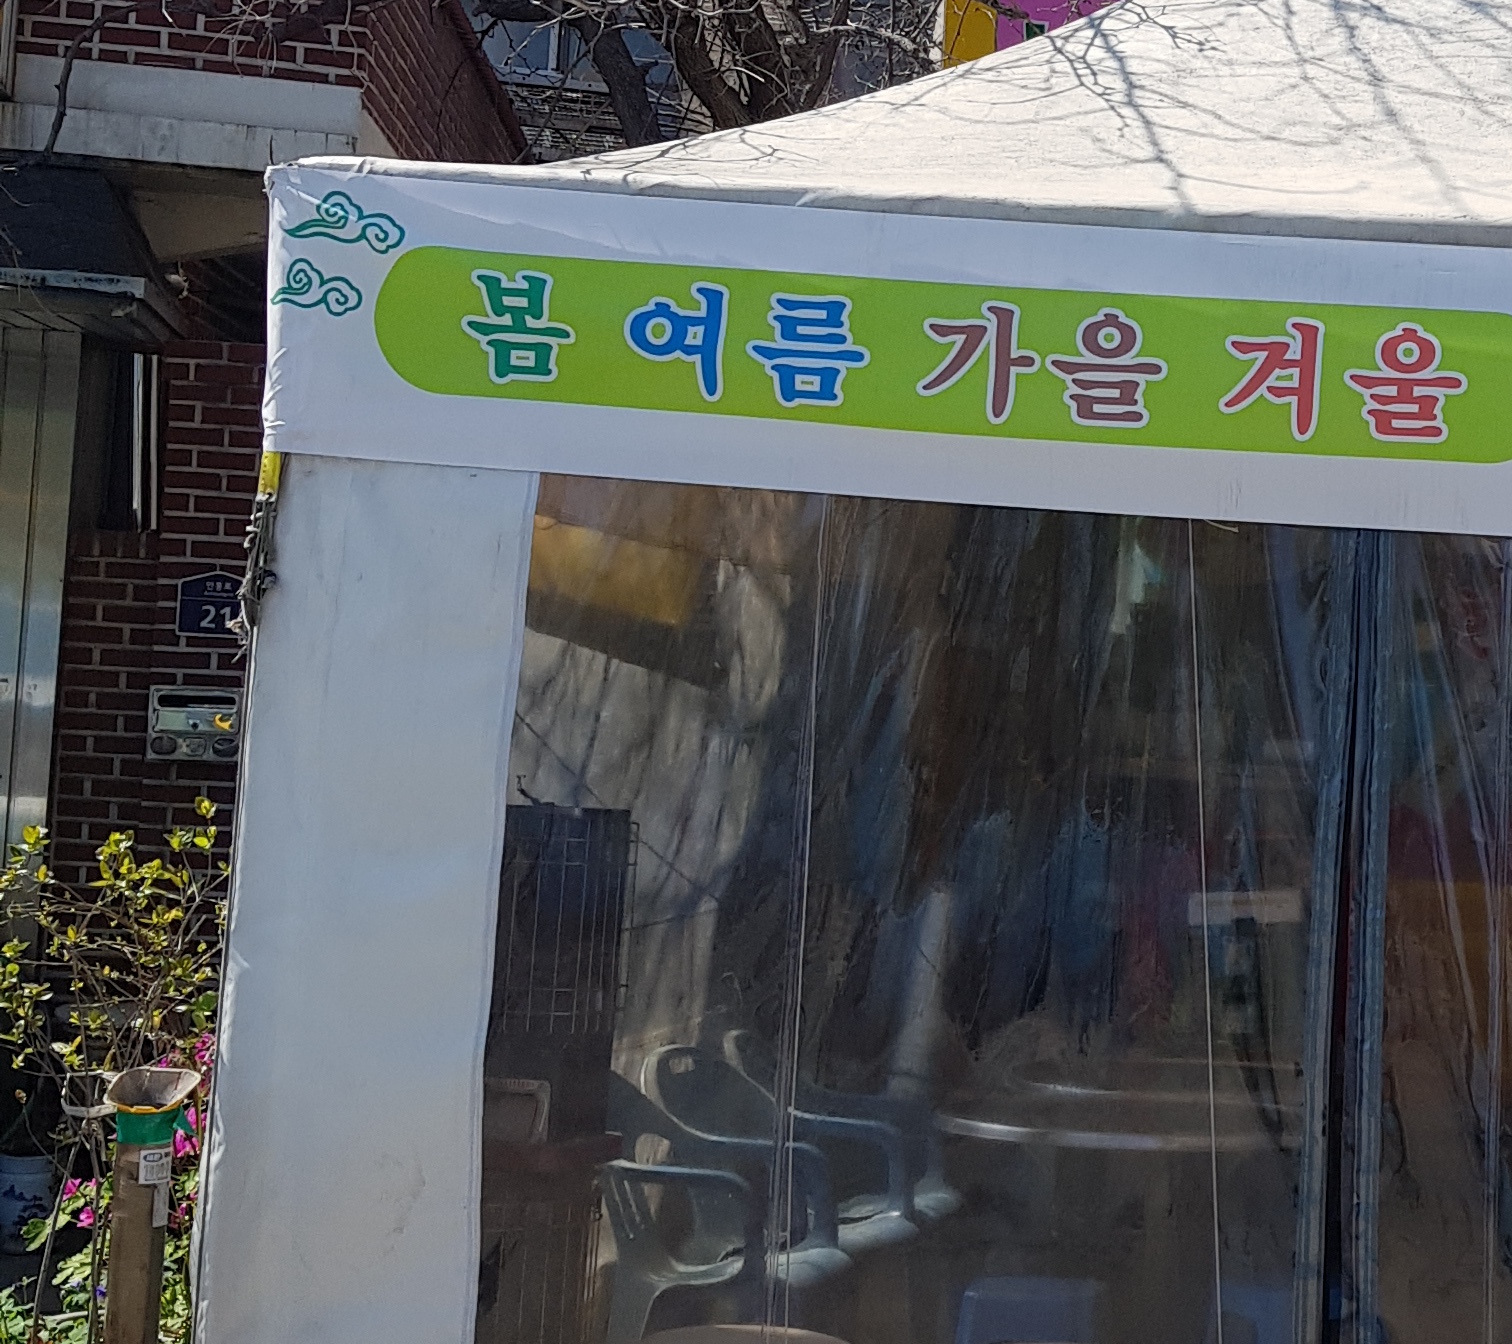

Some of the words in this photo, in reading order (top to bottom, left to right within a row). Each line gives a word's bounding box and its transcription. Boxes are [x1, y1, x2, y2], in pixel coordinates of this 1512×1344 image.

[463, 268, 574, 382] 봄
[624, 281, 870, 406] 여름
[919, 304, 1165, 428] 가을
[1222, 320, 1468, 442] 겨울
[200, 605, 232, 629] 21
